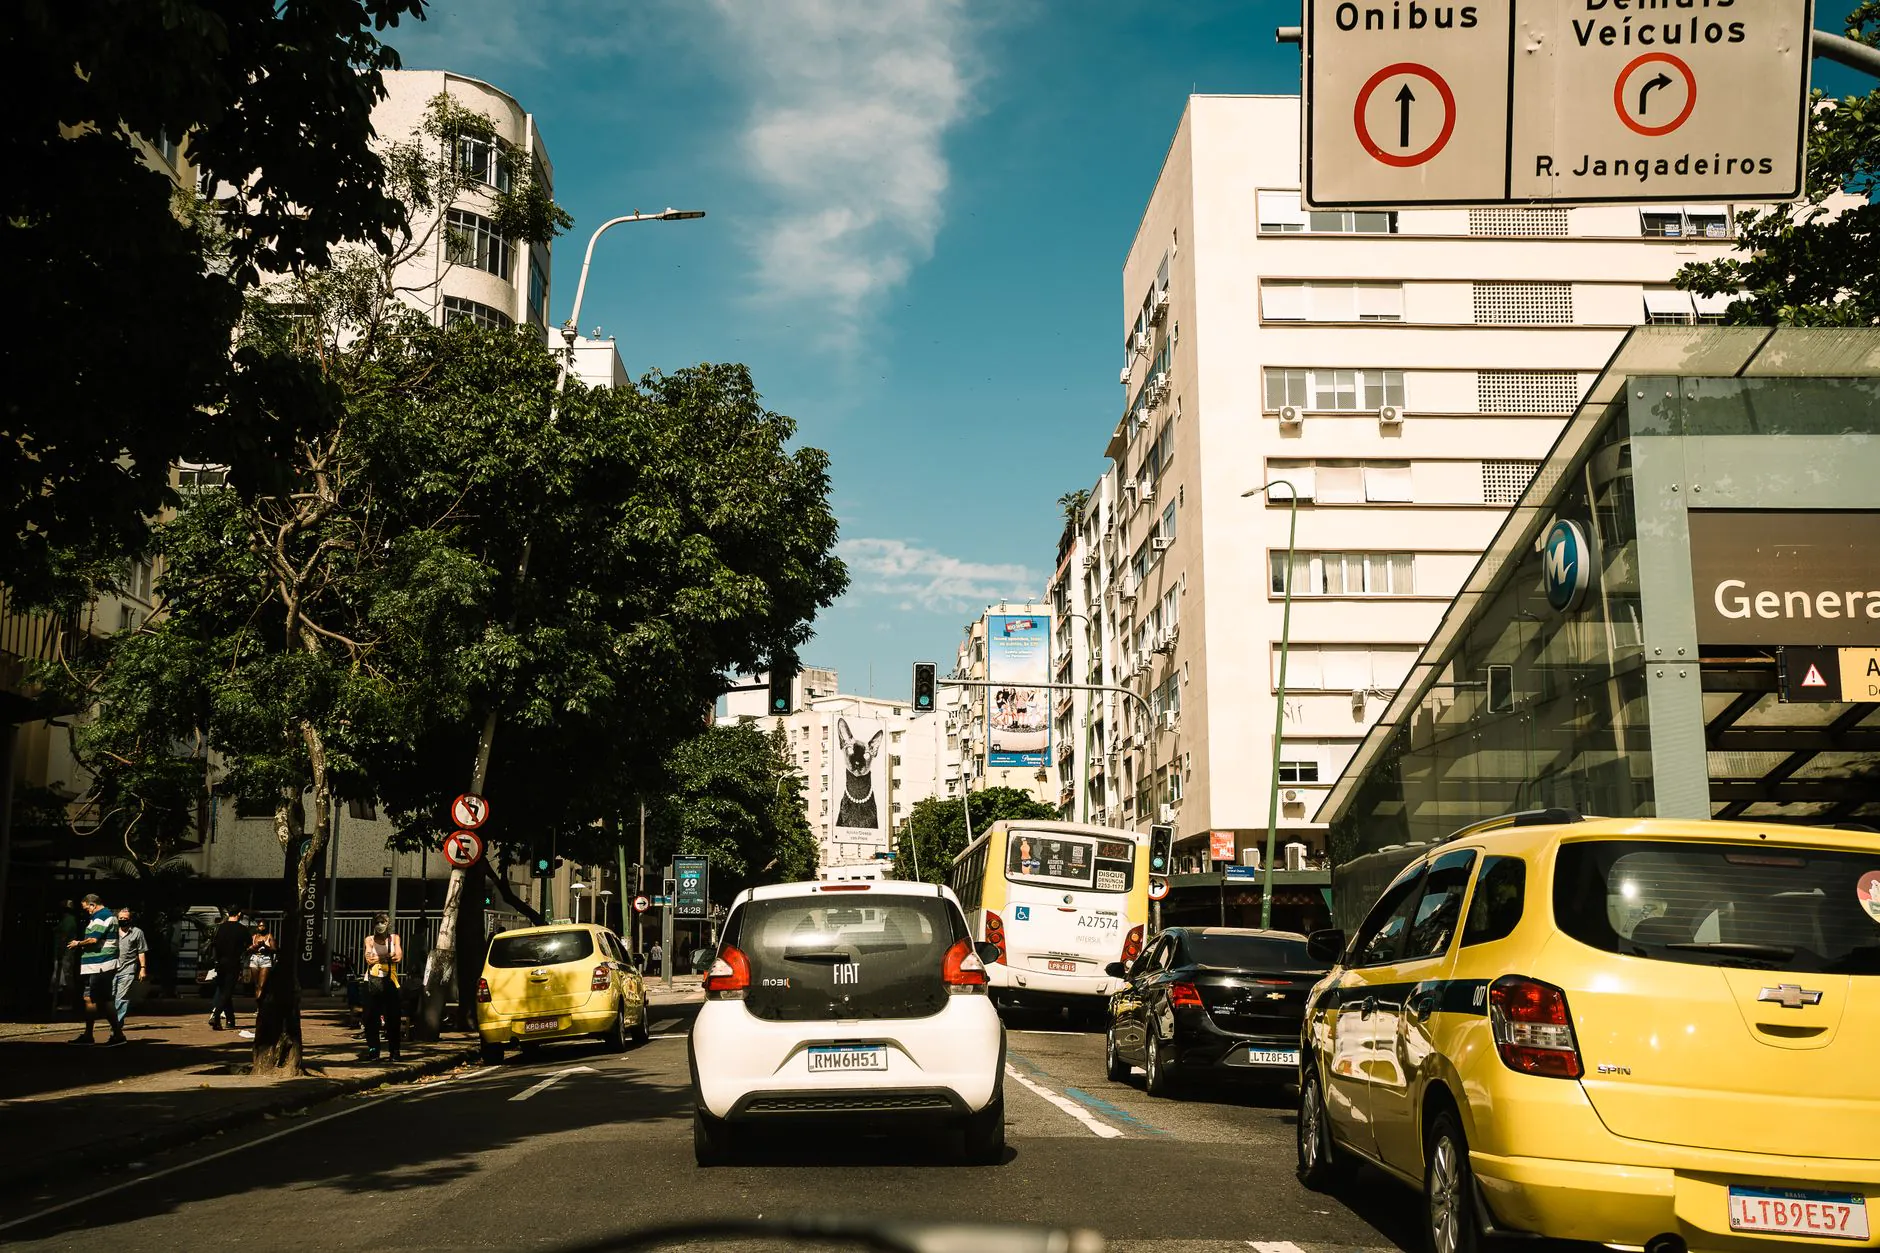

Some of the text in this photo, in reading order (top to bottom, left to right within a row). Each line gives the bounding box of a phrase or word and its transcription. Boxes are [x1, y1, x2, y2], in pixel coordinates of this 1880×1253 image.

[1572, 16, 1745, 46] Veículos
[1536, 153, 1773, 182] R. Jangadeiros
[1869, 684, 1880, 696] D
[1098, 871, 1124, 879] DISQUE
[683, 878, 697, 888] 69
[1077, 915, 1118, 930] A27574
[302, 914, 315, 961] General
[833, 963, 859, 985] FIAT
[815, 1052, 879, 1069] RMW6H51
[1253, 1052, 1294, 1063] LTZ8F51
[1597, 1064, 1631, 1076] SPIN
[1784, 1191, 1807, 1199] BRASIL
[1742, 1199, 1850, 1231] LTB9E57
